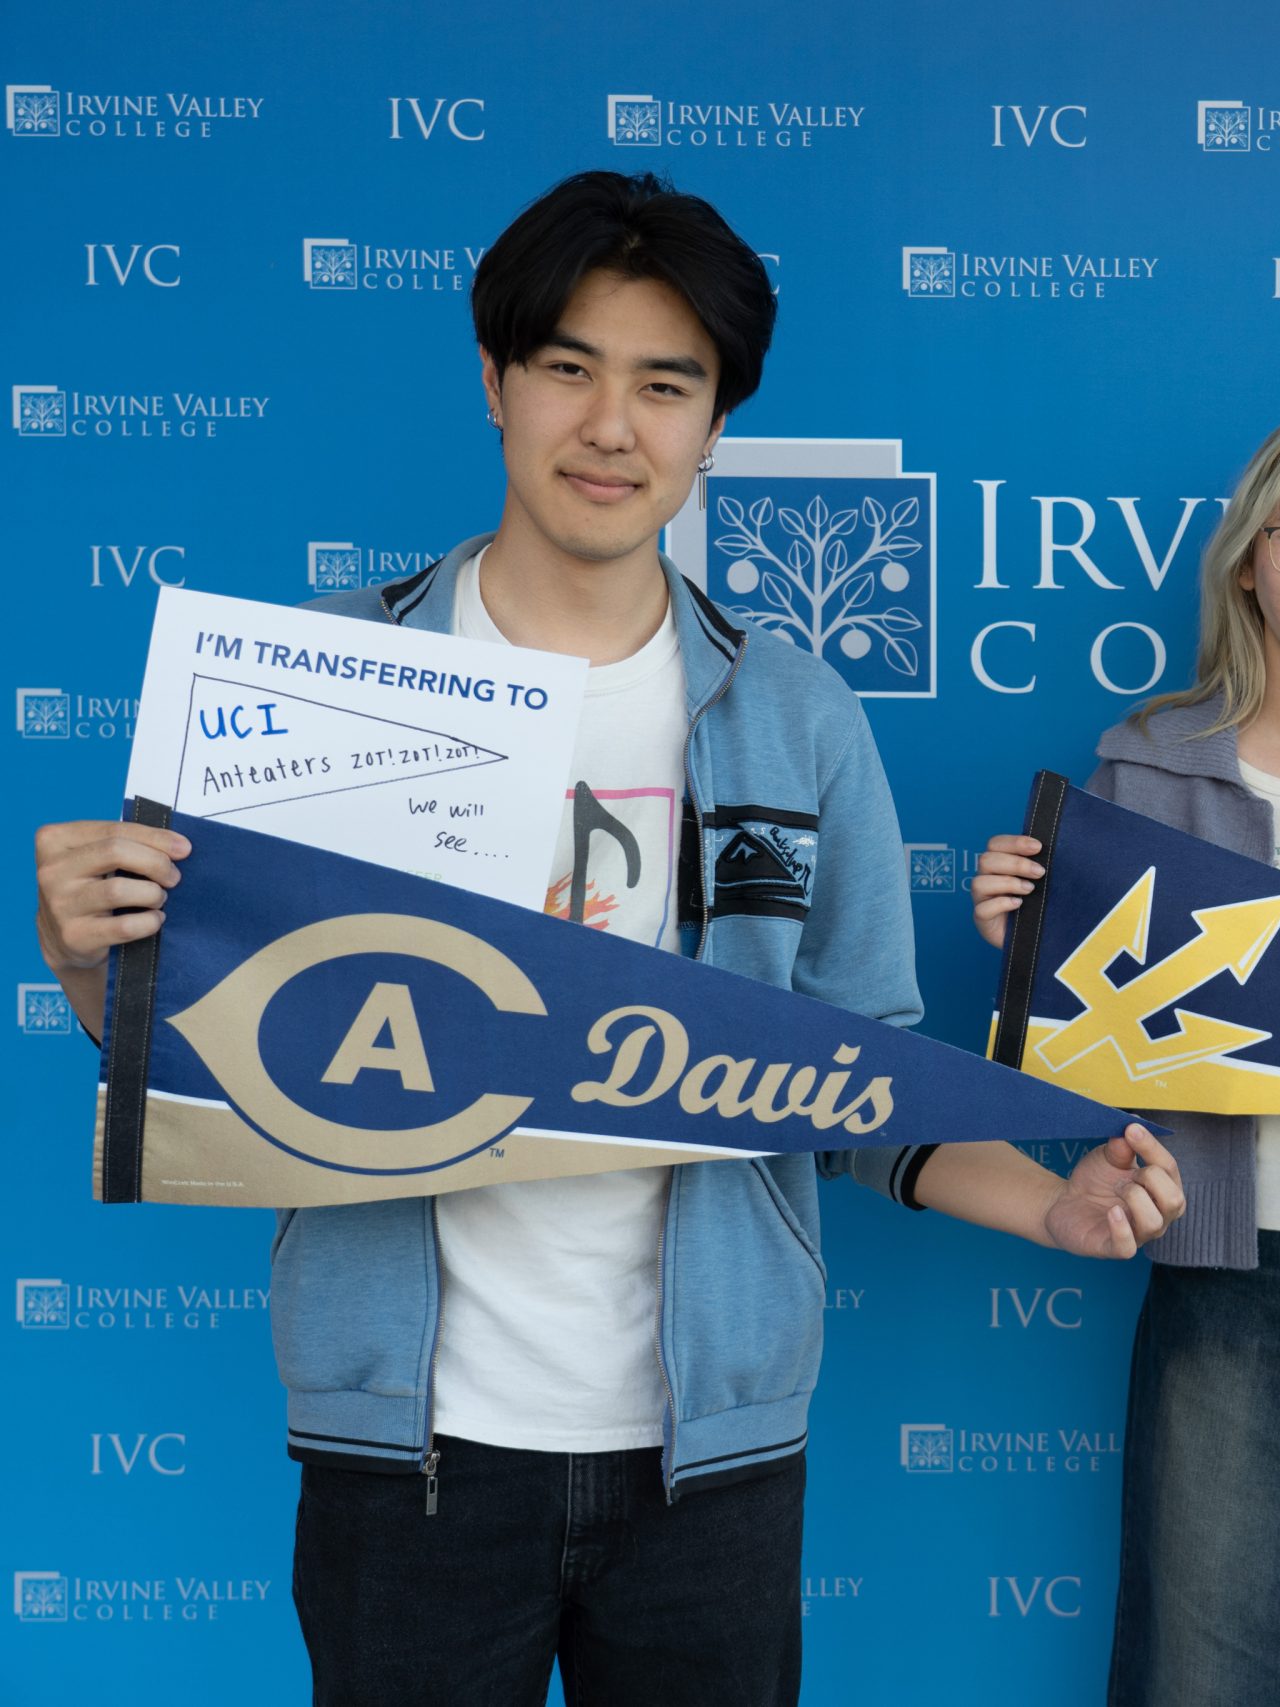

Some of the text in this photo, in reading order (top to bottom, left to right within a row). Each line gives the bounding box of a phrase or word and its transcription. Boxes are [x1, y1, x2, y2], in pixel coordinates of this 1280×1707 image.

[67, 92, 263, 118] IRVINE VALLEY
[669, 102, 864, 126] IRVINE VALLEY
[66, 120, 210, 137] COLLEGE
[390, 98, 484, 140] IVC
[993, 106, 1086, 147] IVC
[667, 130, 811, 146] COLLEGE
[86, 244, 180, 287] IVC
[364, 245, 456, 271] IRVINE
[963, 254, 1158, 277] IRVINE VALLEY
[362, 273, 463, 291] COLLE
[961, 282, 1104, 297] COLLEGE
[73, 392, 269, 417] IRVINE VALLEY
[72, 420, 215, 437] COLLEGE
[973, 480, 1231, 592] IRV
[91, 545, 186, 588] IVC
[195, 631, 549, 711] I'M TRANSFERRING TO
[200, 703, 289, 740] UCI
[202, 754, 332, 797] Anteaters
[449, 802, 485, 819] will
[571, 1004, 895, 1135] Davis
[489, 1148, 505, 1159] TM
[77, 1285, 271, 1309] IRVINE VALLEY
[990, 1288, 1081, 1328] IVC
[75, 1312, 217, 1328] COLLEGE
[960, 1429, 1121, 1452] IRVINE VALL
[92, 1433, 185, 1475] IVC
[958, 1456, 1100, 1472] COLLEGE
[75, 1578, 270, 1600] IRVINE VALLEY
[801, 1577, 863, 1597] LLEY
[989, 1576, 1080, 1616] IVC
[74, 1605, 215, 1620] COLLEGE
